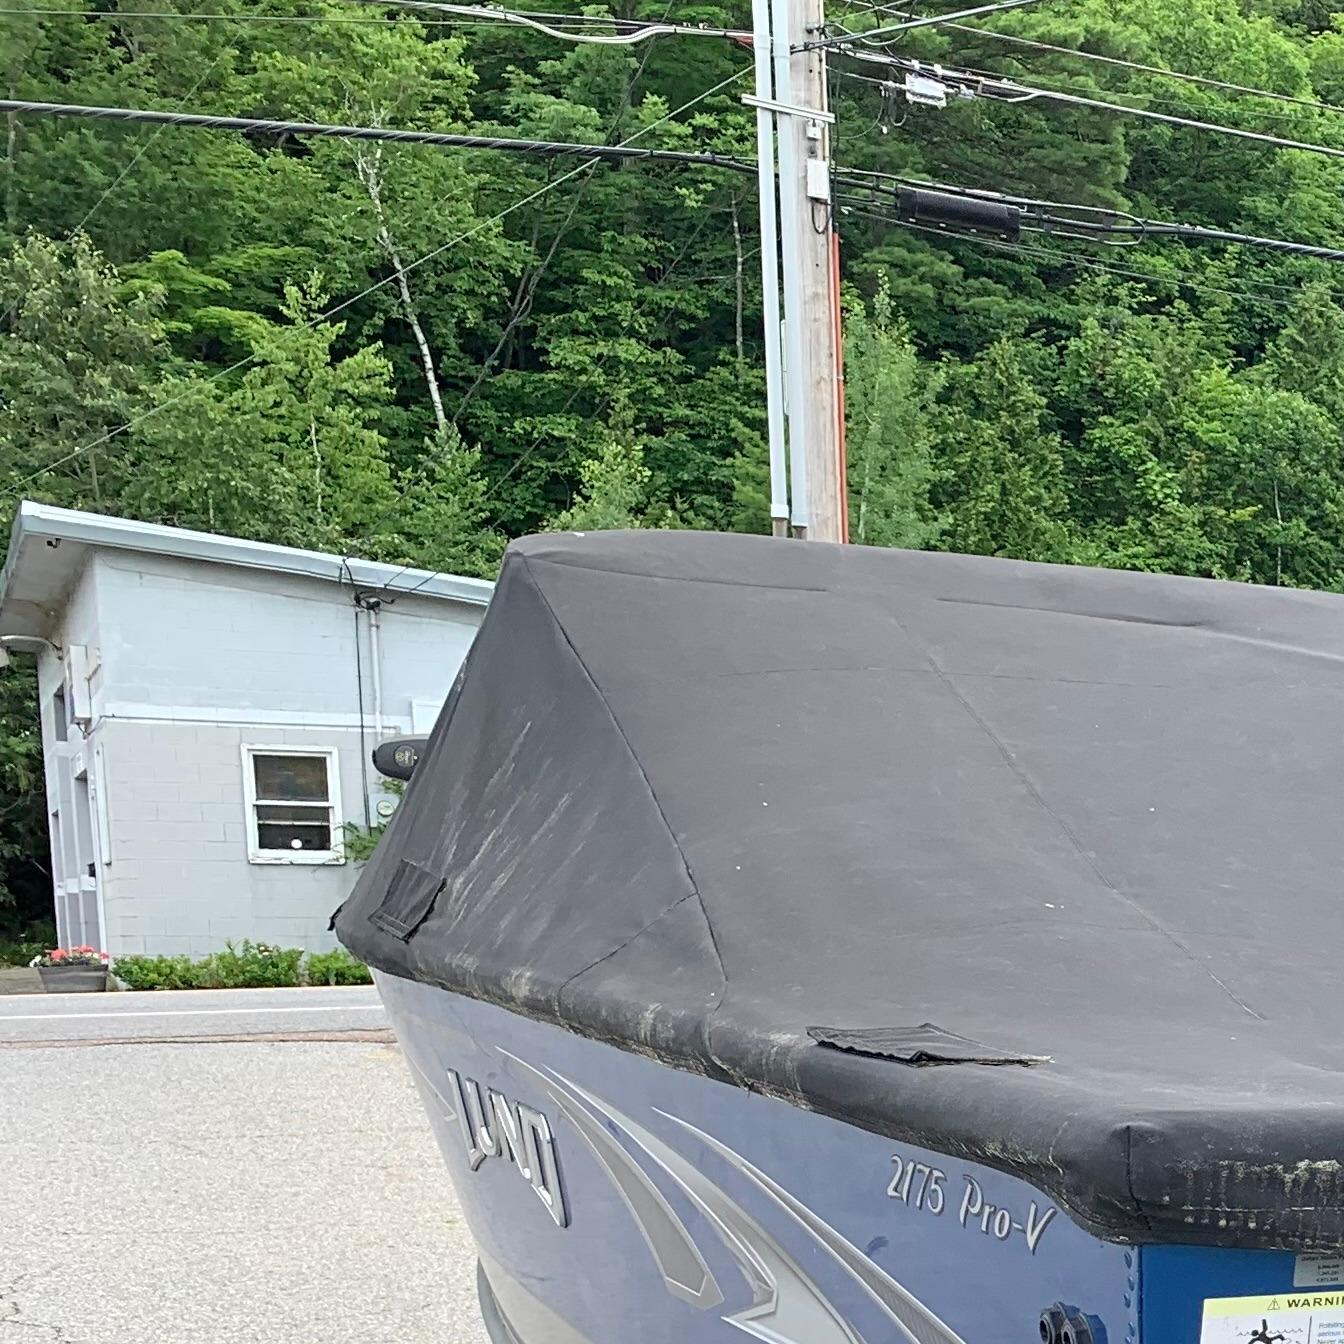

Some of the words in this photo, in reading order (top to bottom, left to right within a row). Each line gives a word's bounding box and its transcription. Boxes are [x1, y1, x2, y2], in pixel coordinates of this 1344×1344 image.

[447, 1068, 571, 1228] LUND
[886, 1153, 947, 1216] 2175
[959, 1174, 1057, 1256] Pro-V
